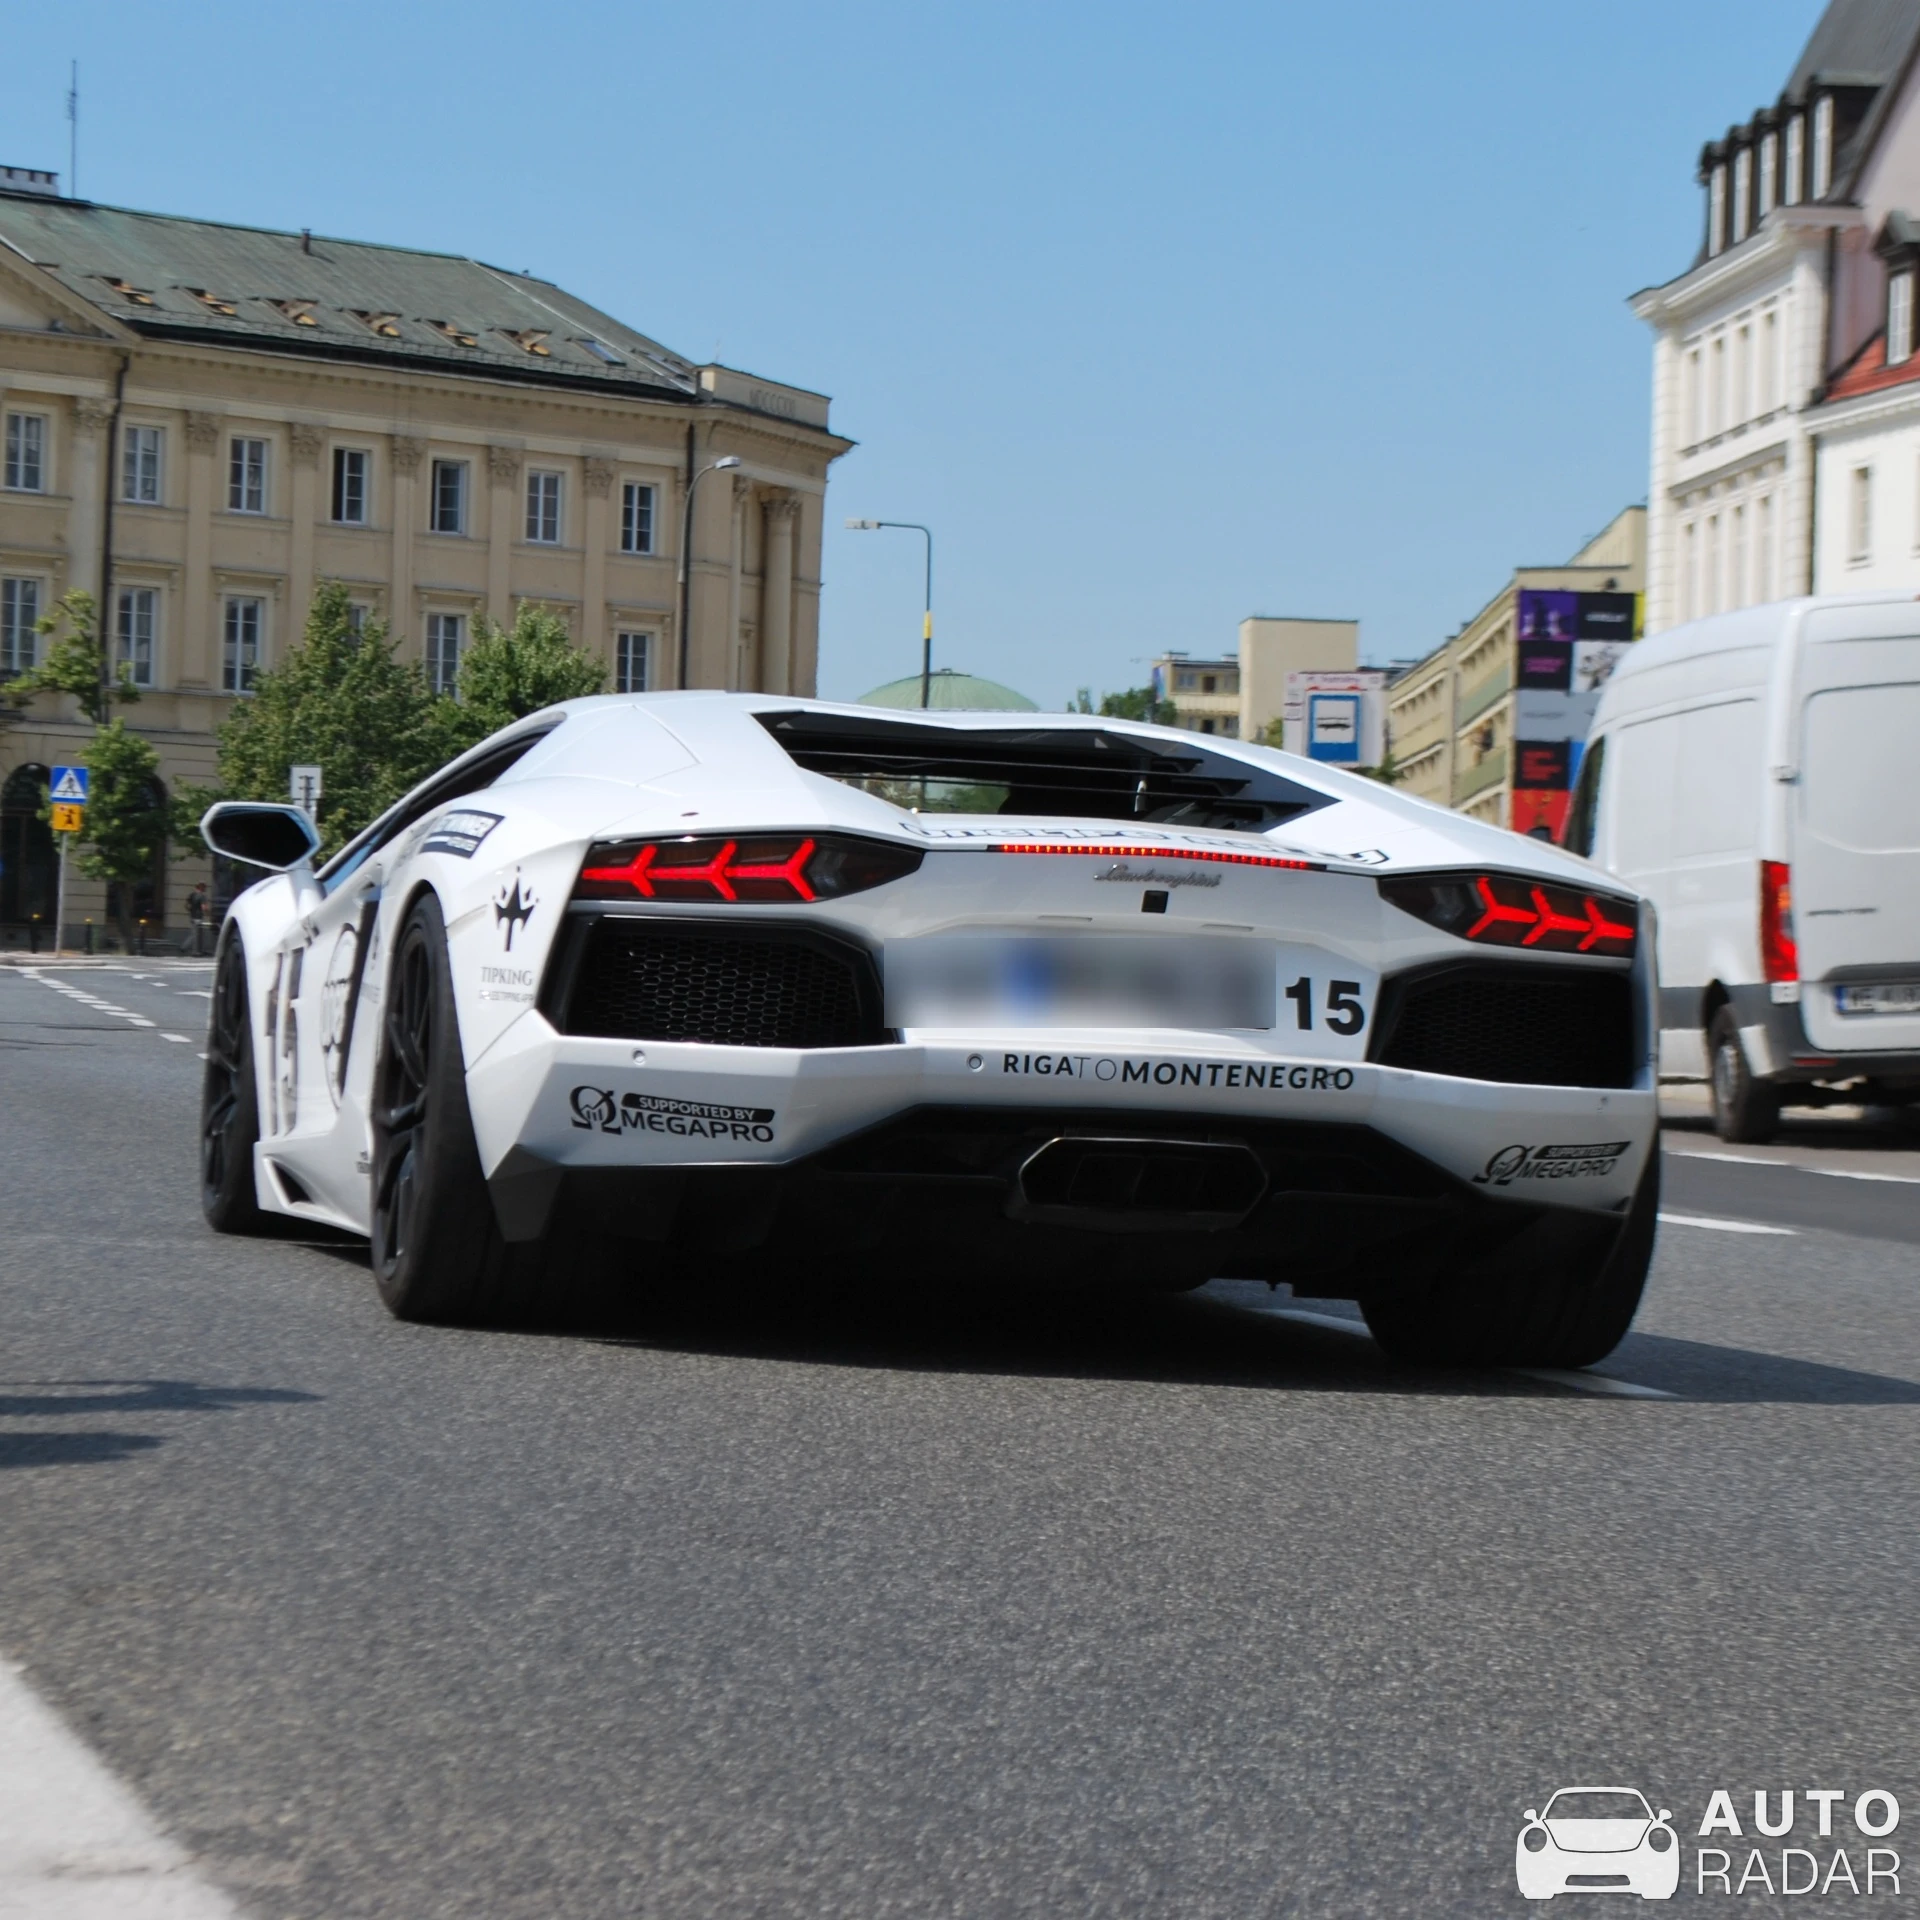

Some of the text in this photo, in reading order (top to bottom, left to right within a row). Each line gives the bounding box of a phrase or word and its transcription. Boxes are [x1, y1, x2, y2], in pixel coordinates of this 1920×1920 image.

[480, 966, 533, 986] TIPKING
[1285, 976, 1365, 1036] 15
[639, 1096, 755, 1121] SUPPORTED BY
